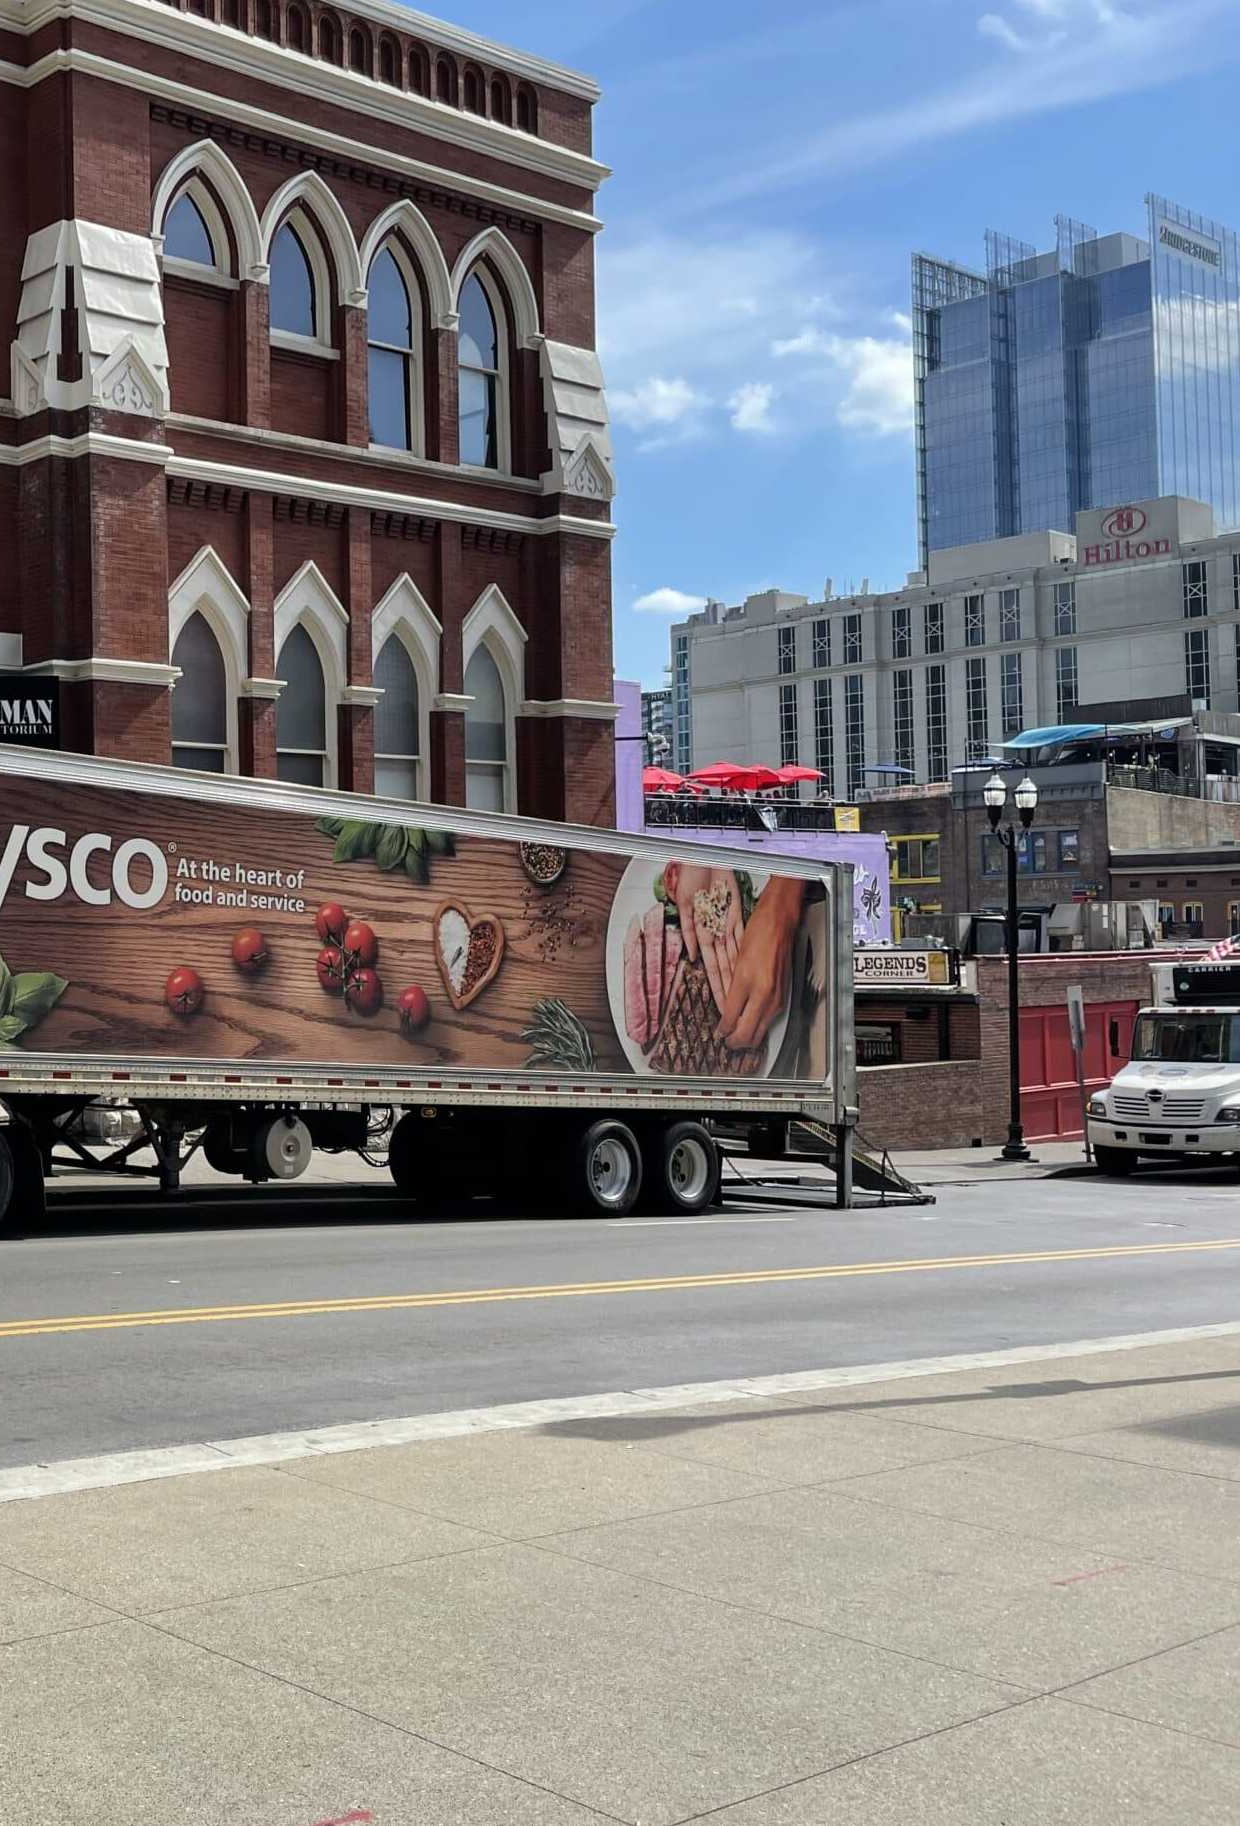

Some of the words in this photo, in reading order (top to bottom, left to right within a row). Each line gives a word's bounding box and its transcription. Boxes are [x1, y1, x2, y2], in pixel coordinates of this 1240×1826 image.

[1084, 539, 1171, 566] Hilton
[176, 858, 198, 879] At
[201, 860, 230, 882] the
[235, 863, 282, 887] heart
[286, 869, 305, 889] of
[175, 882, 213, 904] food
[217, 889, 247, 907] and
[250, 893, 305, 913] service
[854, 957, 926, 973] LEGENDS
